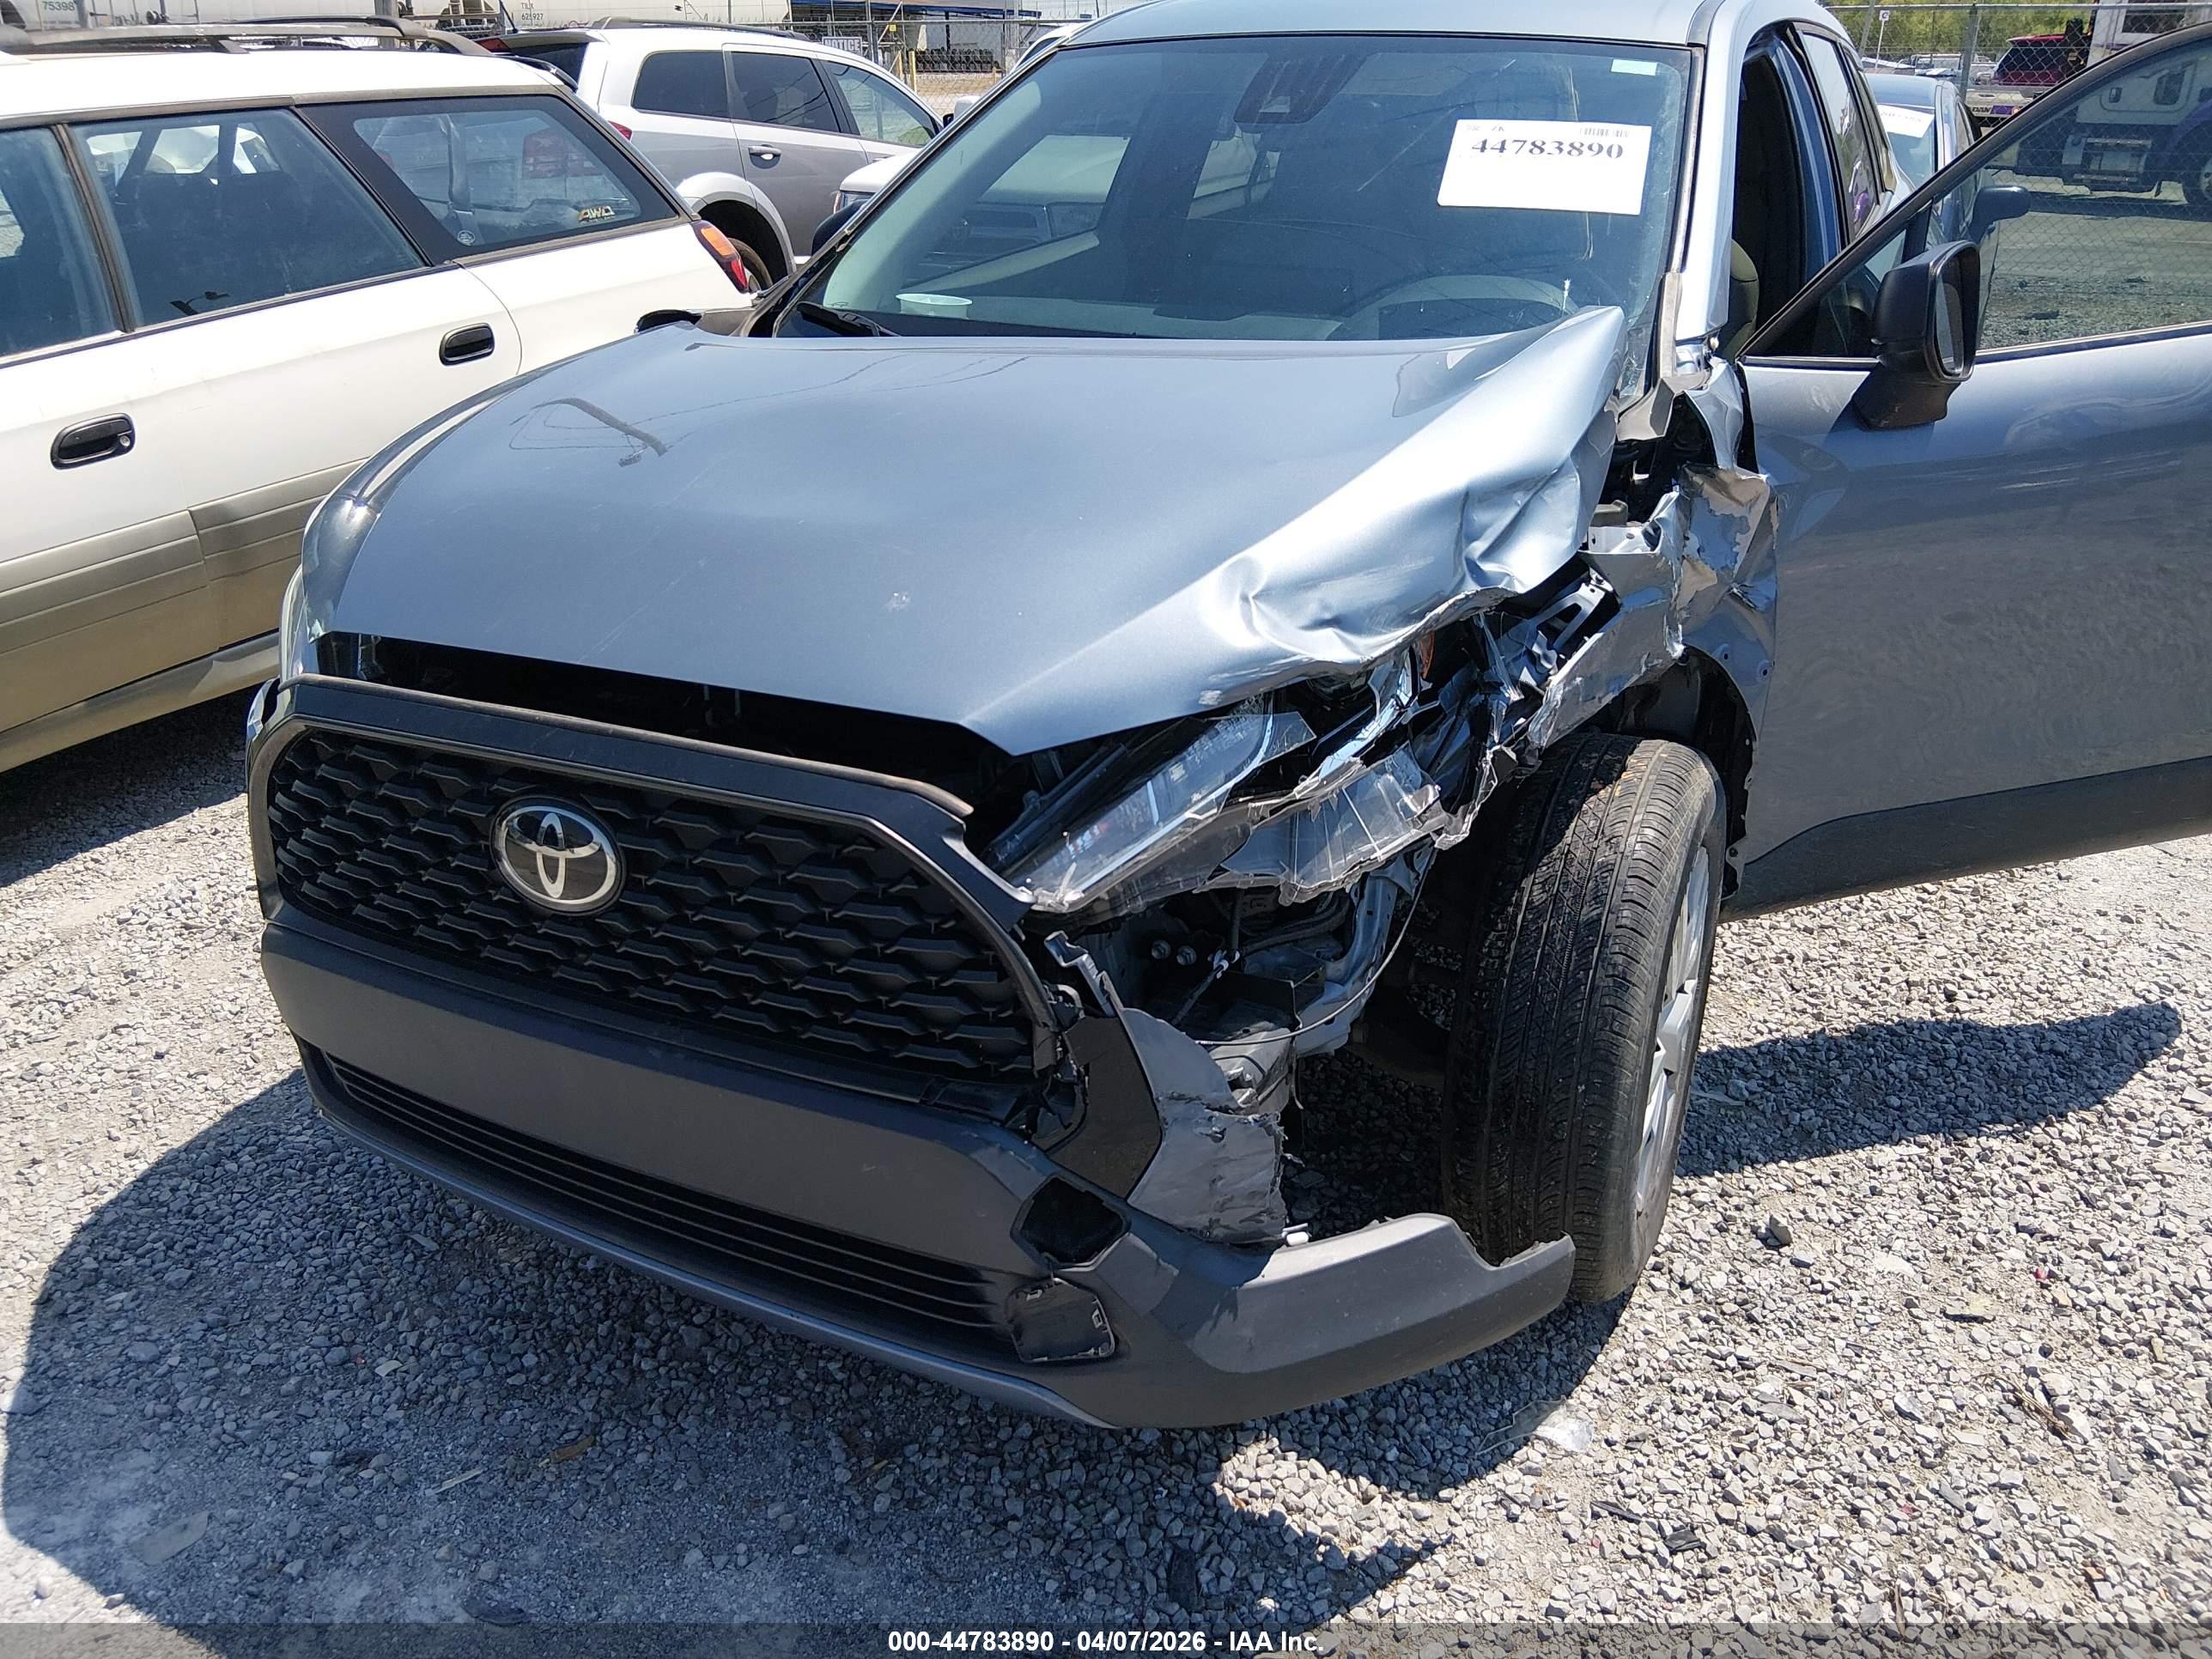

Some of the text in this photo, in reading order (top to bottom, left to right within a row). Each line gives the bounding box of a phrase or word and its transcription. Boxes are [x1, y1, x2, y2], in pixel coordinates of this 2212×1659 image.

[41, 1, 76, 11] 75398
[824, 40, 860, 51] NOTICE
[1471, 138, 1624, 159] 44783890
[578, 205, 616, 222] AWD
